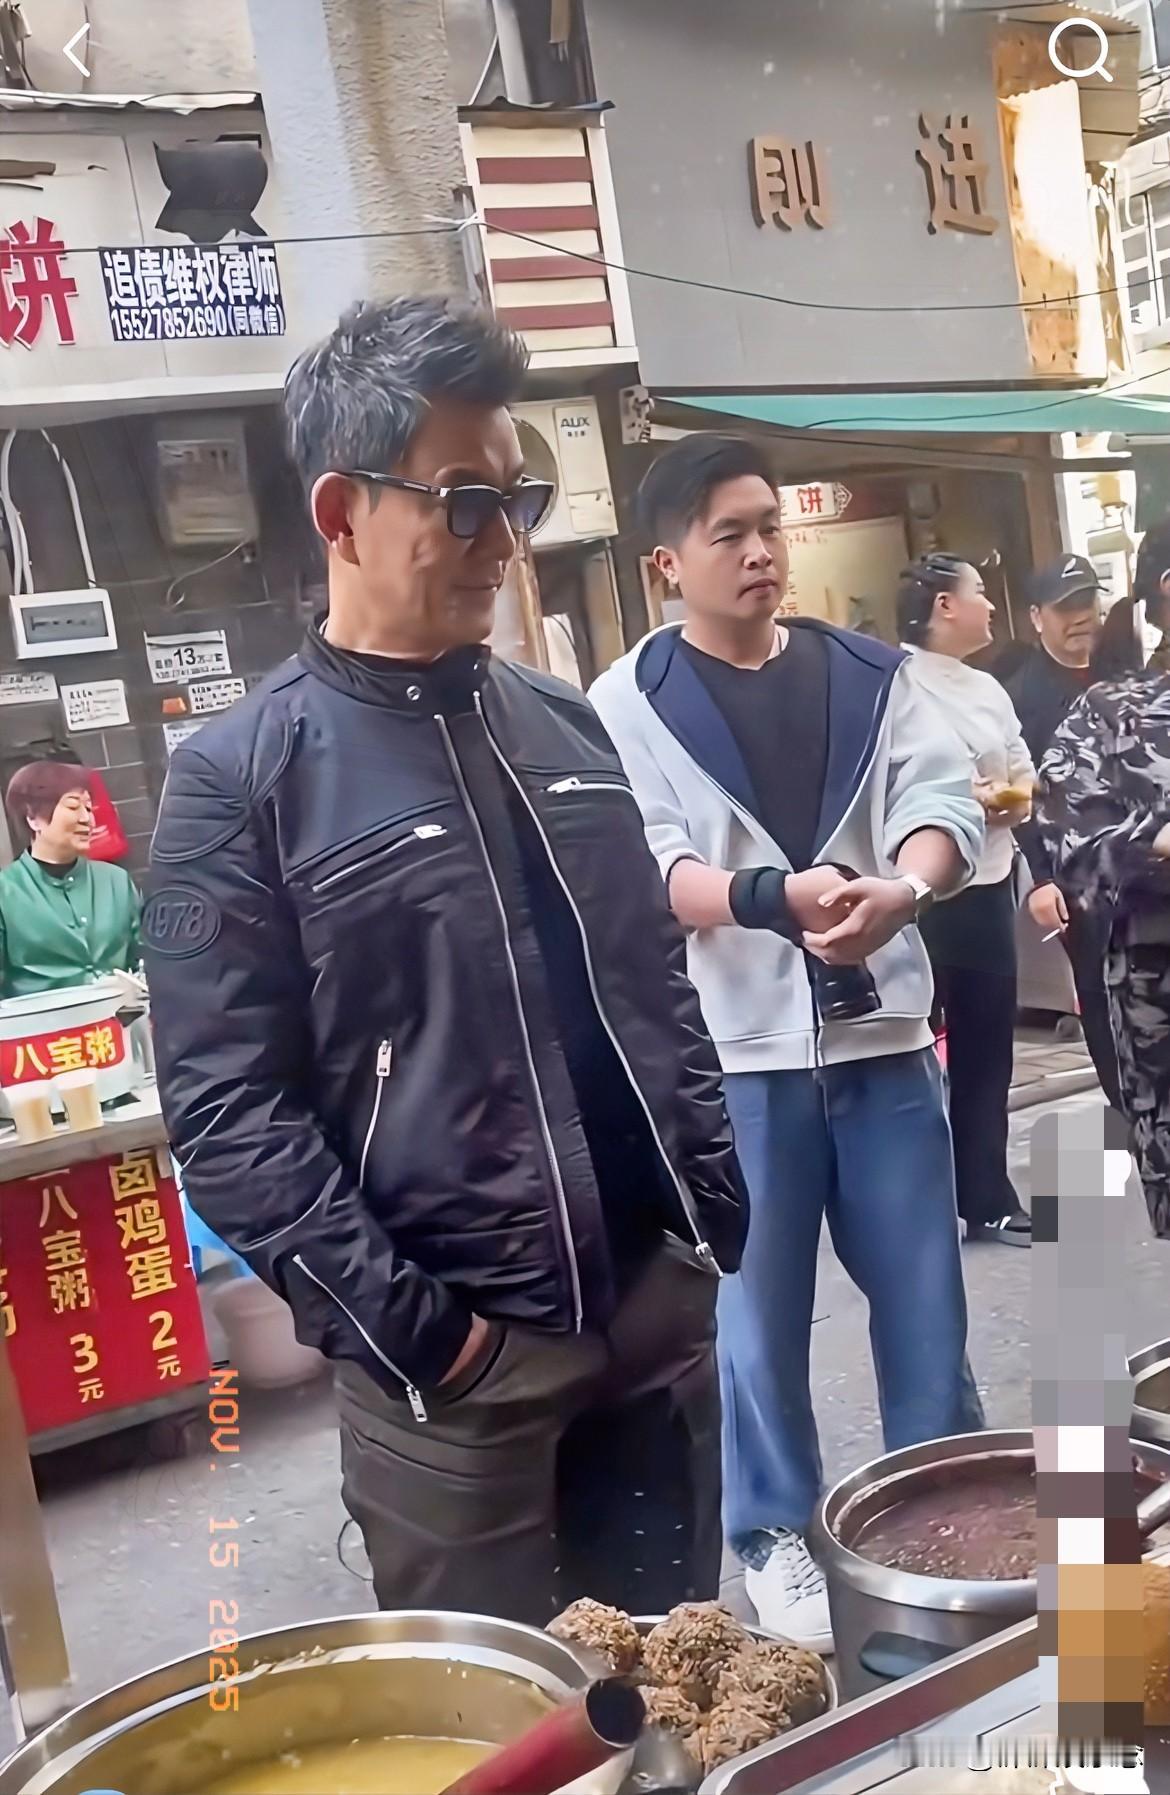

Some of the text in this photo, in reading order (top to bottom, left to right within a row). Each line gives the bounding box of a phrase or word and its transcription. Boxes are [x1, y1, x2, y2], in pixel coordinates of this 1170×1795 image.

[0, 215, 79, 350] 饼
[104, 244, 281, 308] 追债维权律师
[110, 303, 287, 340] 15527852690(同微信)
[560, 416, 591, 428] AUX
[173, 646, 196, 667] 13
[147, 901, 205, 940] 1978
[13, 1025, 117, 1079] 八宝粥
[108, 1147, 178, 1301] 卤鸡蛋
